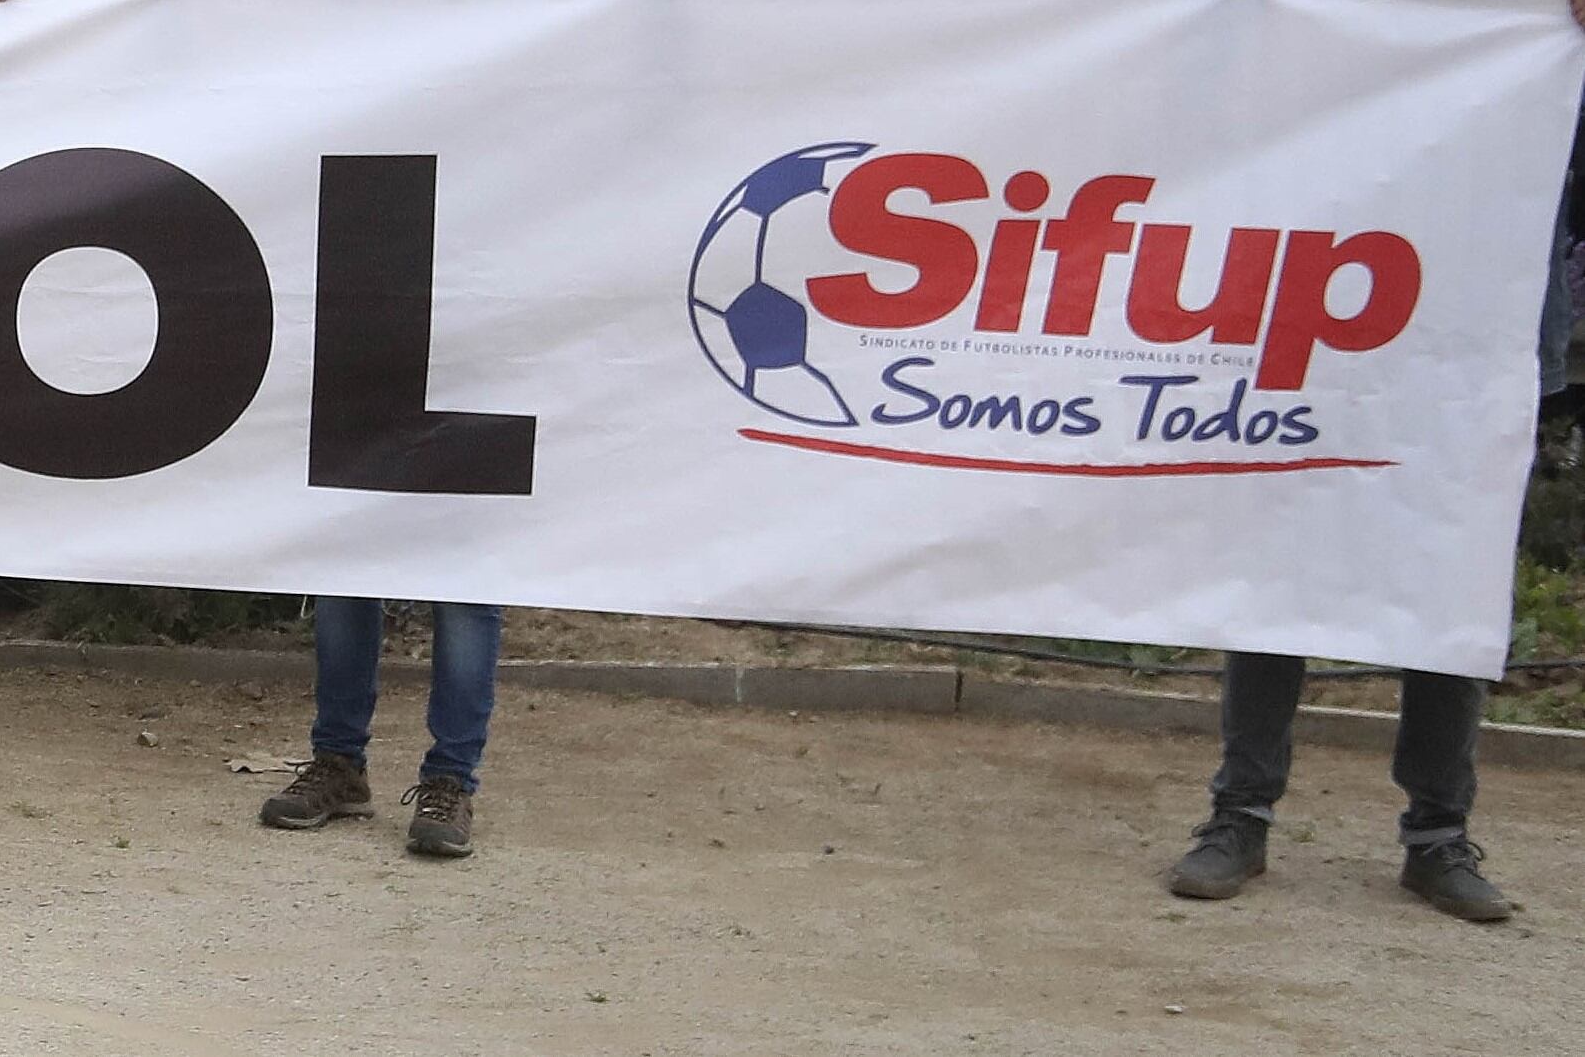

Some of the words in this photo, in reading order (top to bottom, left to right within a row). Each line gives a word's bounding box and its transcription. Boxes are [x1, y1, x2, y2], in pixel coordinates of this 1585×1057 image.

[805, 152, 1423, 391] Sifup
[872, 356, 1102, 438] Somos
[1120, 374, 1319, 446] Todos
